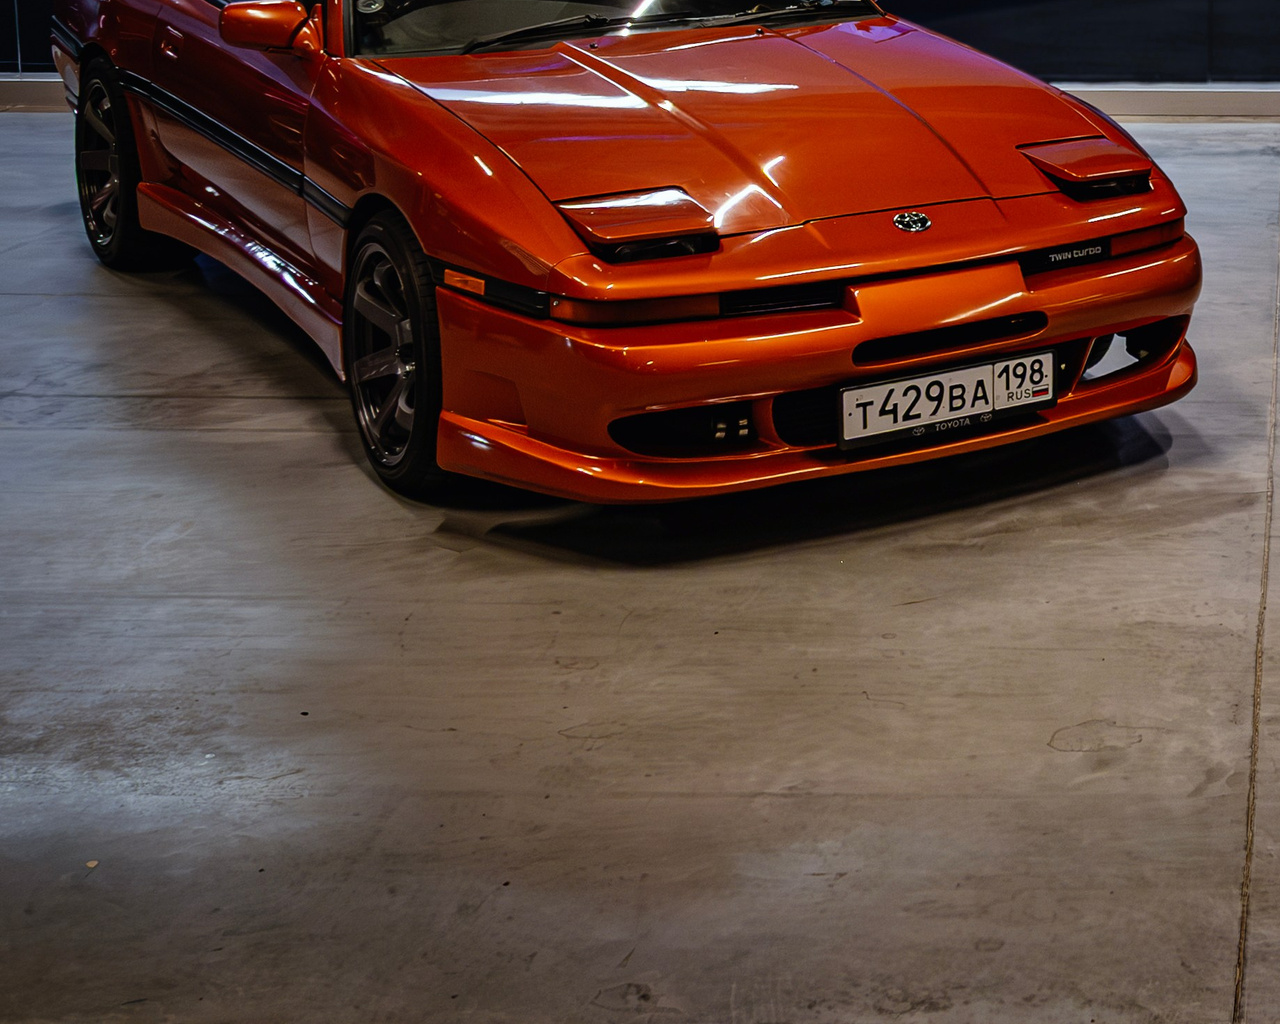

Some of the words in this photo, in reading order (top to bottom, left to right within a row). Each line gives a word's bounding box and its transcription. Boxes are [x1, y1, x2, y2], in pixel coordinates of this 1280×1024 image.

[1049, 252, 1072, 262] TWIN
[997, 358, 1044, 391] 198
[1007, 388, 1031, 402] RUS
[935, 418, 971, 432] TOYOTA
